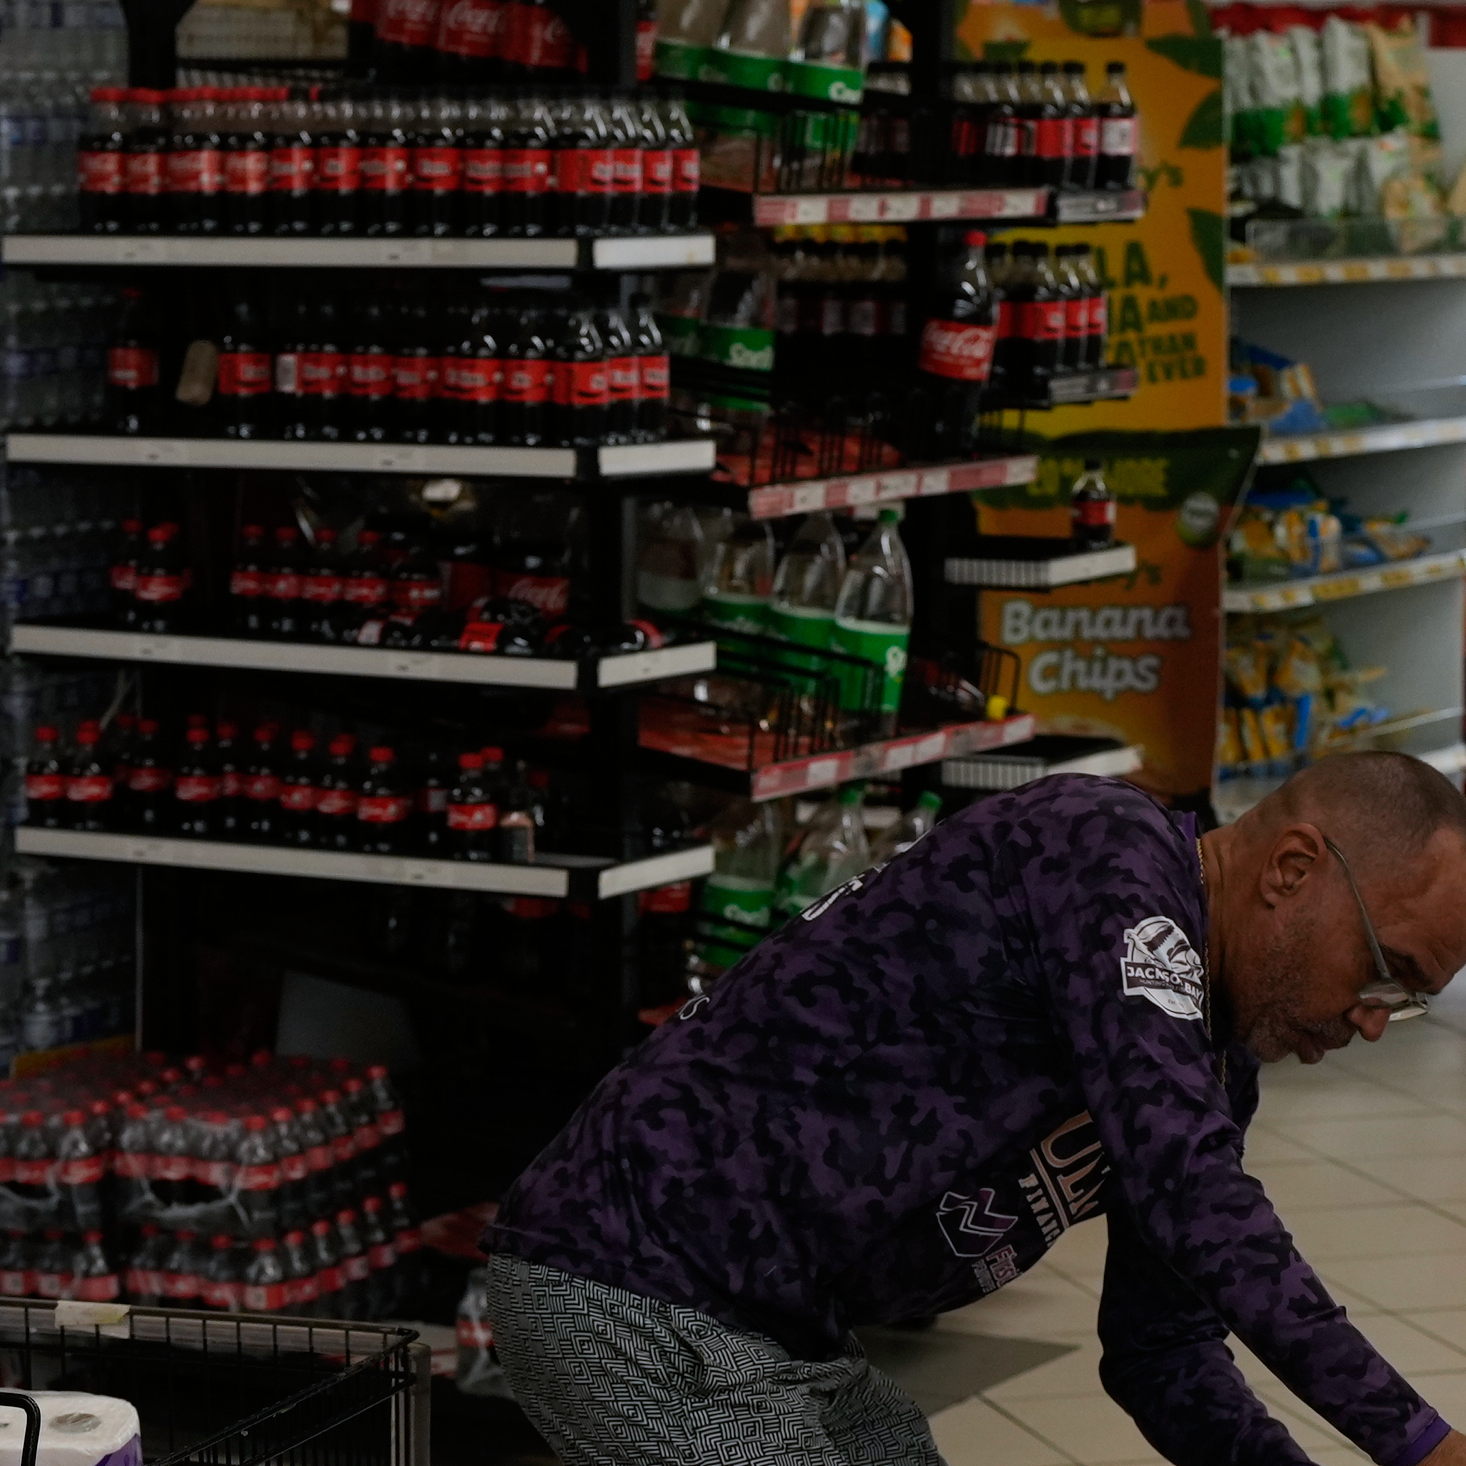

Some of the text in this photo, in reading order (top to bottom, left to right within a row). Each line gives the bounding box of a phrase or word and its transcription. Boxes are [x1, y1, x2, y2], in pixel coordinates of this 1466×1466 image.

[1146, 357, 1206, 384] EVER
[1000, 600, 1192, 645] Banana
[1028, 646, 1163, 702] Chips
